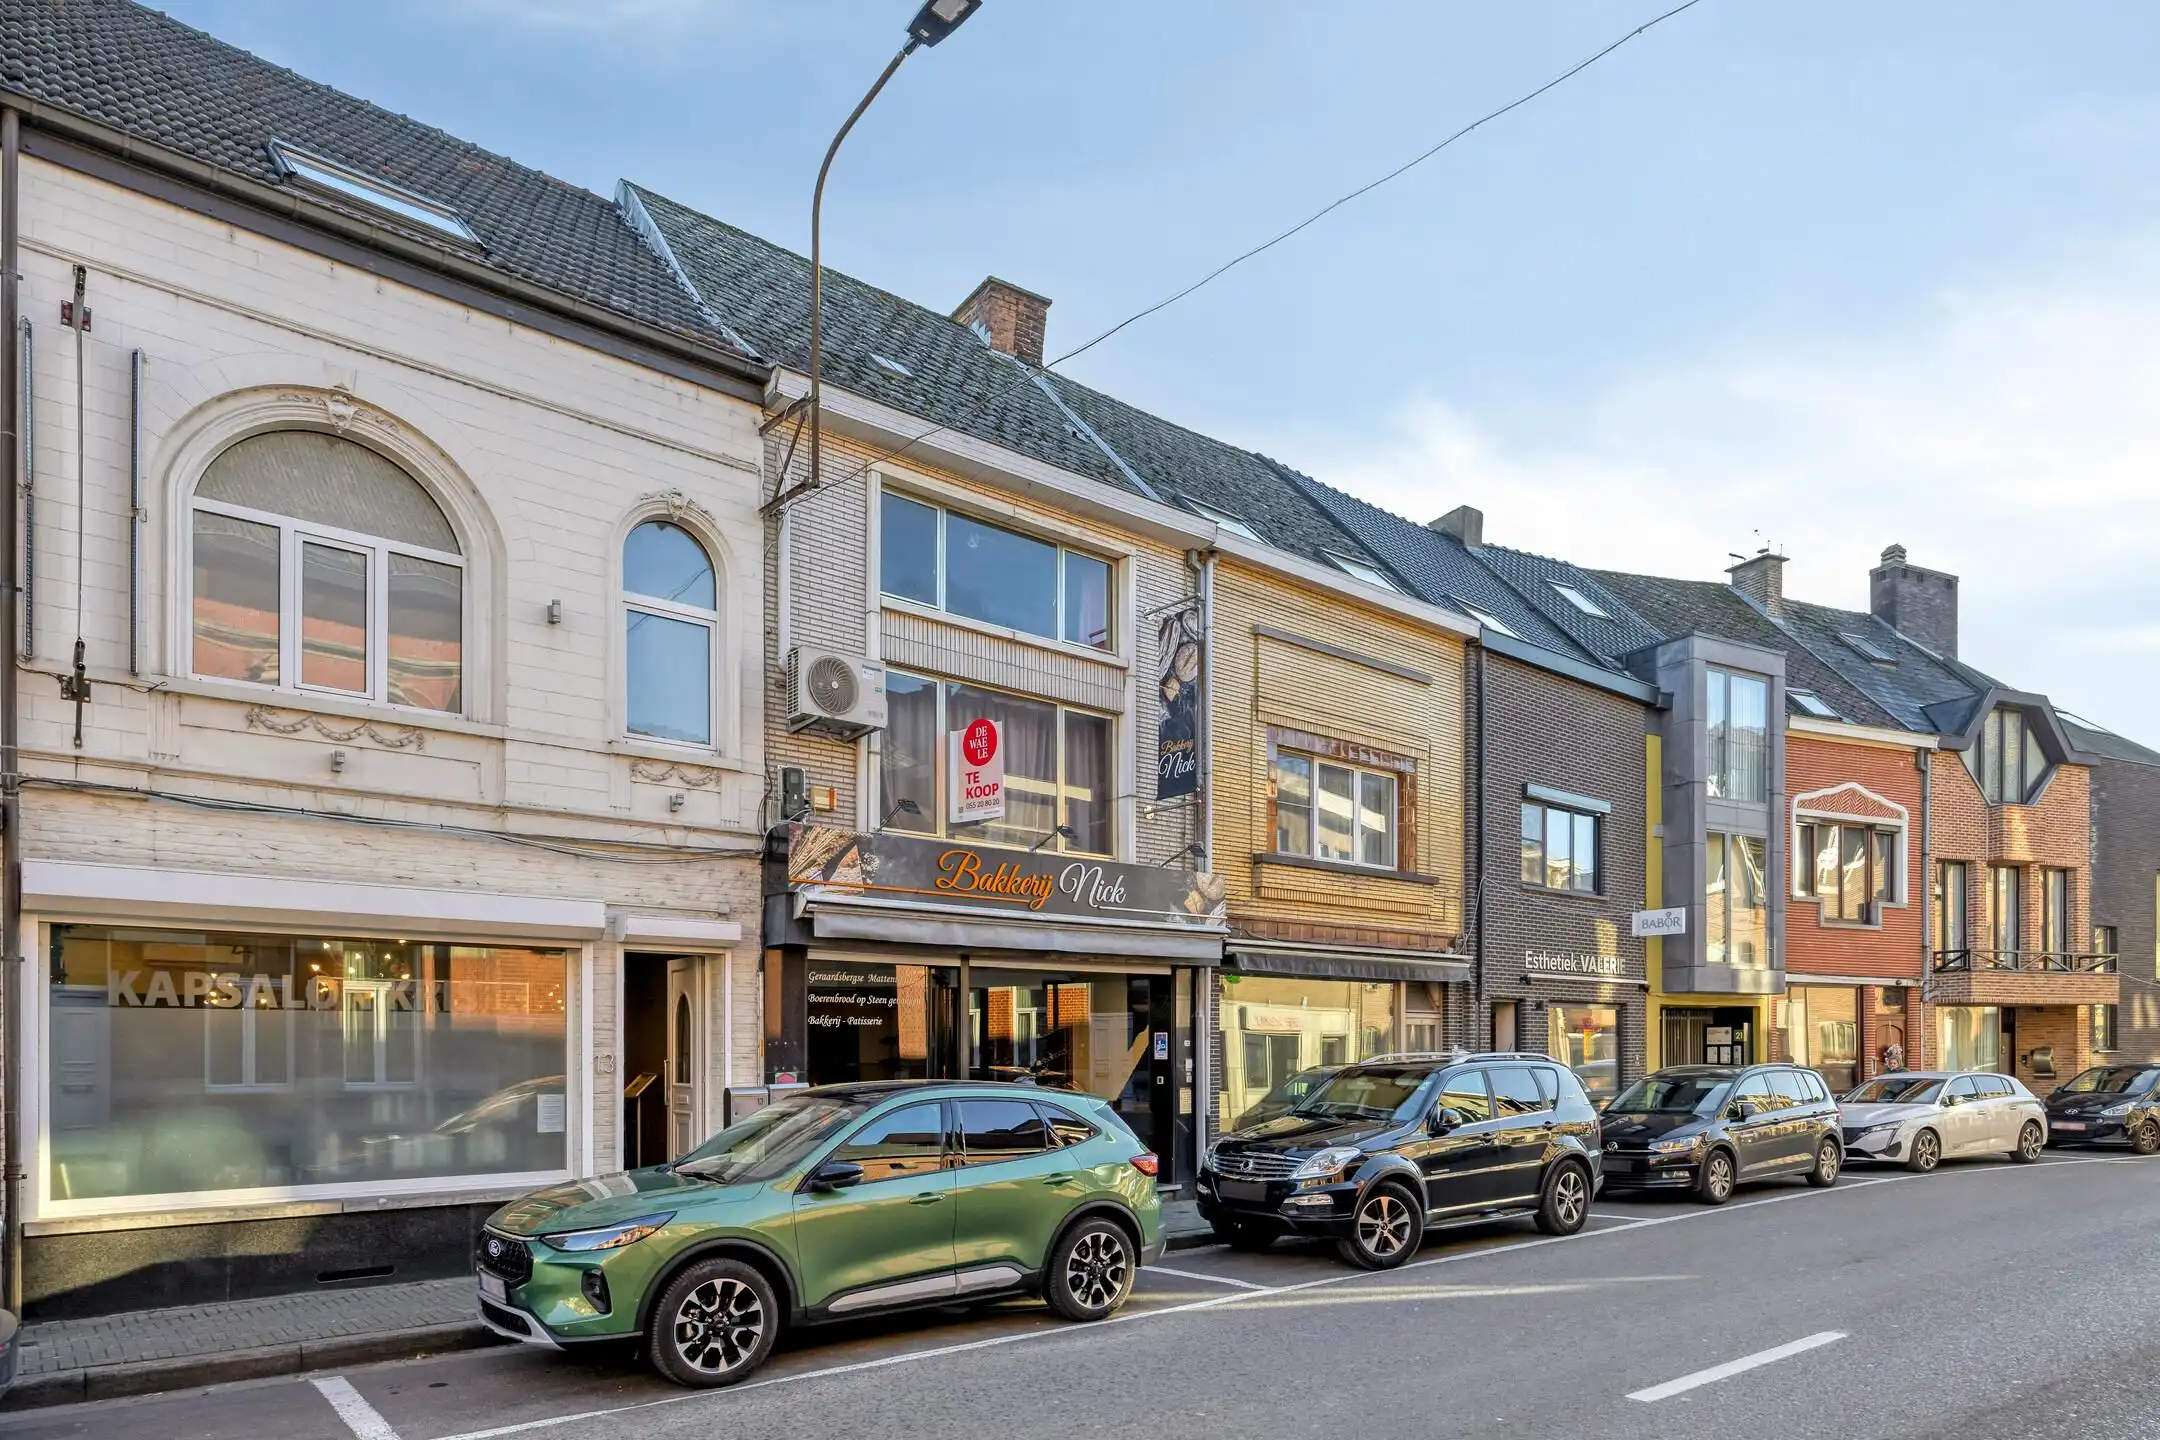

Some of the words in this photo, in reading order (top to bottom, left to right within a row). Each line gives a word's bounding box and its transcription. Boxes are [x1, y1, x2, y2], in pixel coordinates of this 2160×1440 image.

[976, 726, 988, 738] DE
[970, 737, 988, 749] WAE
[977, 748, 988, 759] LE
[1158, 752, 1196, 779] Nick
[966, 772, 980, 784] TE
[966, 783, 999, 799] KOOP
[966, 802, 976, 810] 055
[977, 800, 985, 808] 20
[993, 798, 1000, 806] 20
[935, 850, 1054, 911] Bakkerij
[1059, 862, 1127, 908] Nick
[1641, 916, 1682, 930] BABOR
[1525, 950, 1577, 972] Esthetiek
[1579, 954, 1626, 975] VALERIE
[808, 972, 864, 984] Geraardsbergse
[387, 978, 478, 1014] KRIS
[808, 992, 857, 1004] Boerenbrood
[856, 997, 867, 1007] op
[867, 994, 887, 1005] Steen
[808, 1014, 841, 1028] Bakkerij
[847, 1015, 883, 1026] Patisserie
[1735, 1031, 1743, 1040] 21
[592, 1054, 615, 1074] 13
